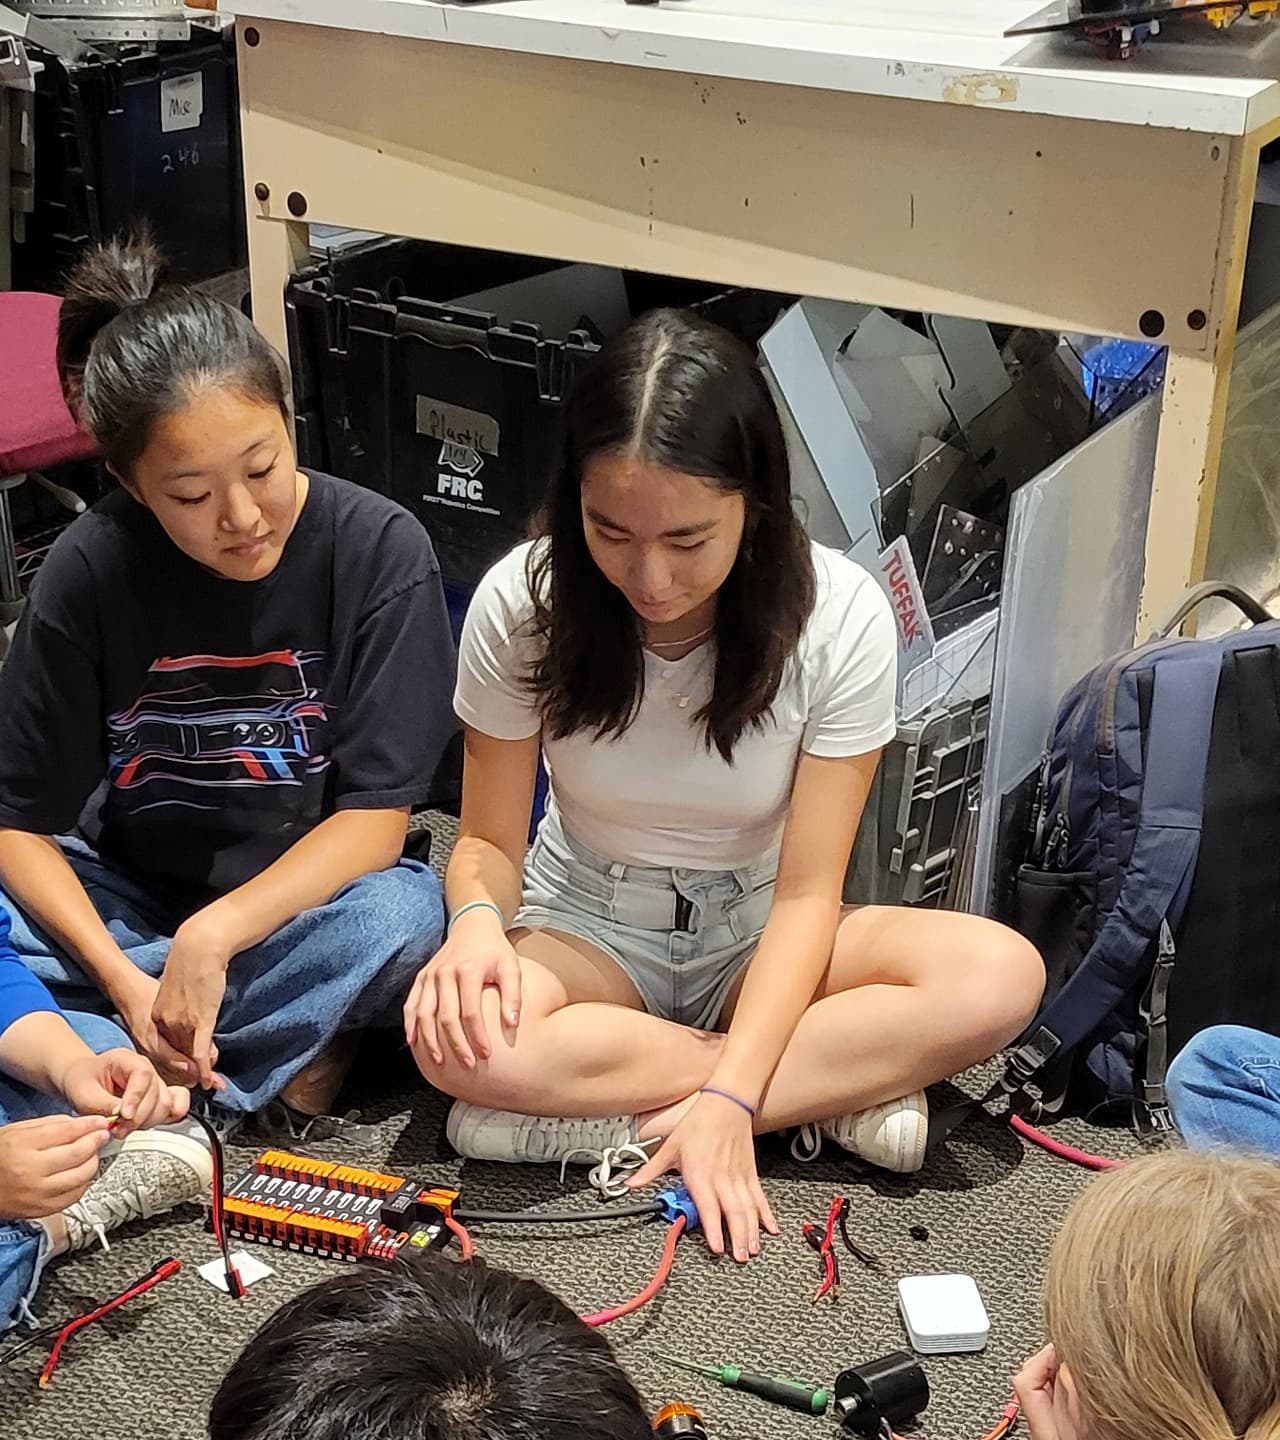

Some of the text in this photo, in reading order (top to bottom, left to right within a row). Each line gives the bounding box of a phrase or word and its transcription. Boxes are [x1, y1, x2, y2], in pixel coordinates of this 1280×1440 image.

[161, 142, 199, 173] 246
[430, 409, 492, 451] Plastic
[437, 473, 484, 501] FRC
[881, 548, 924, 650] TUFFAK
